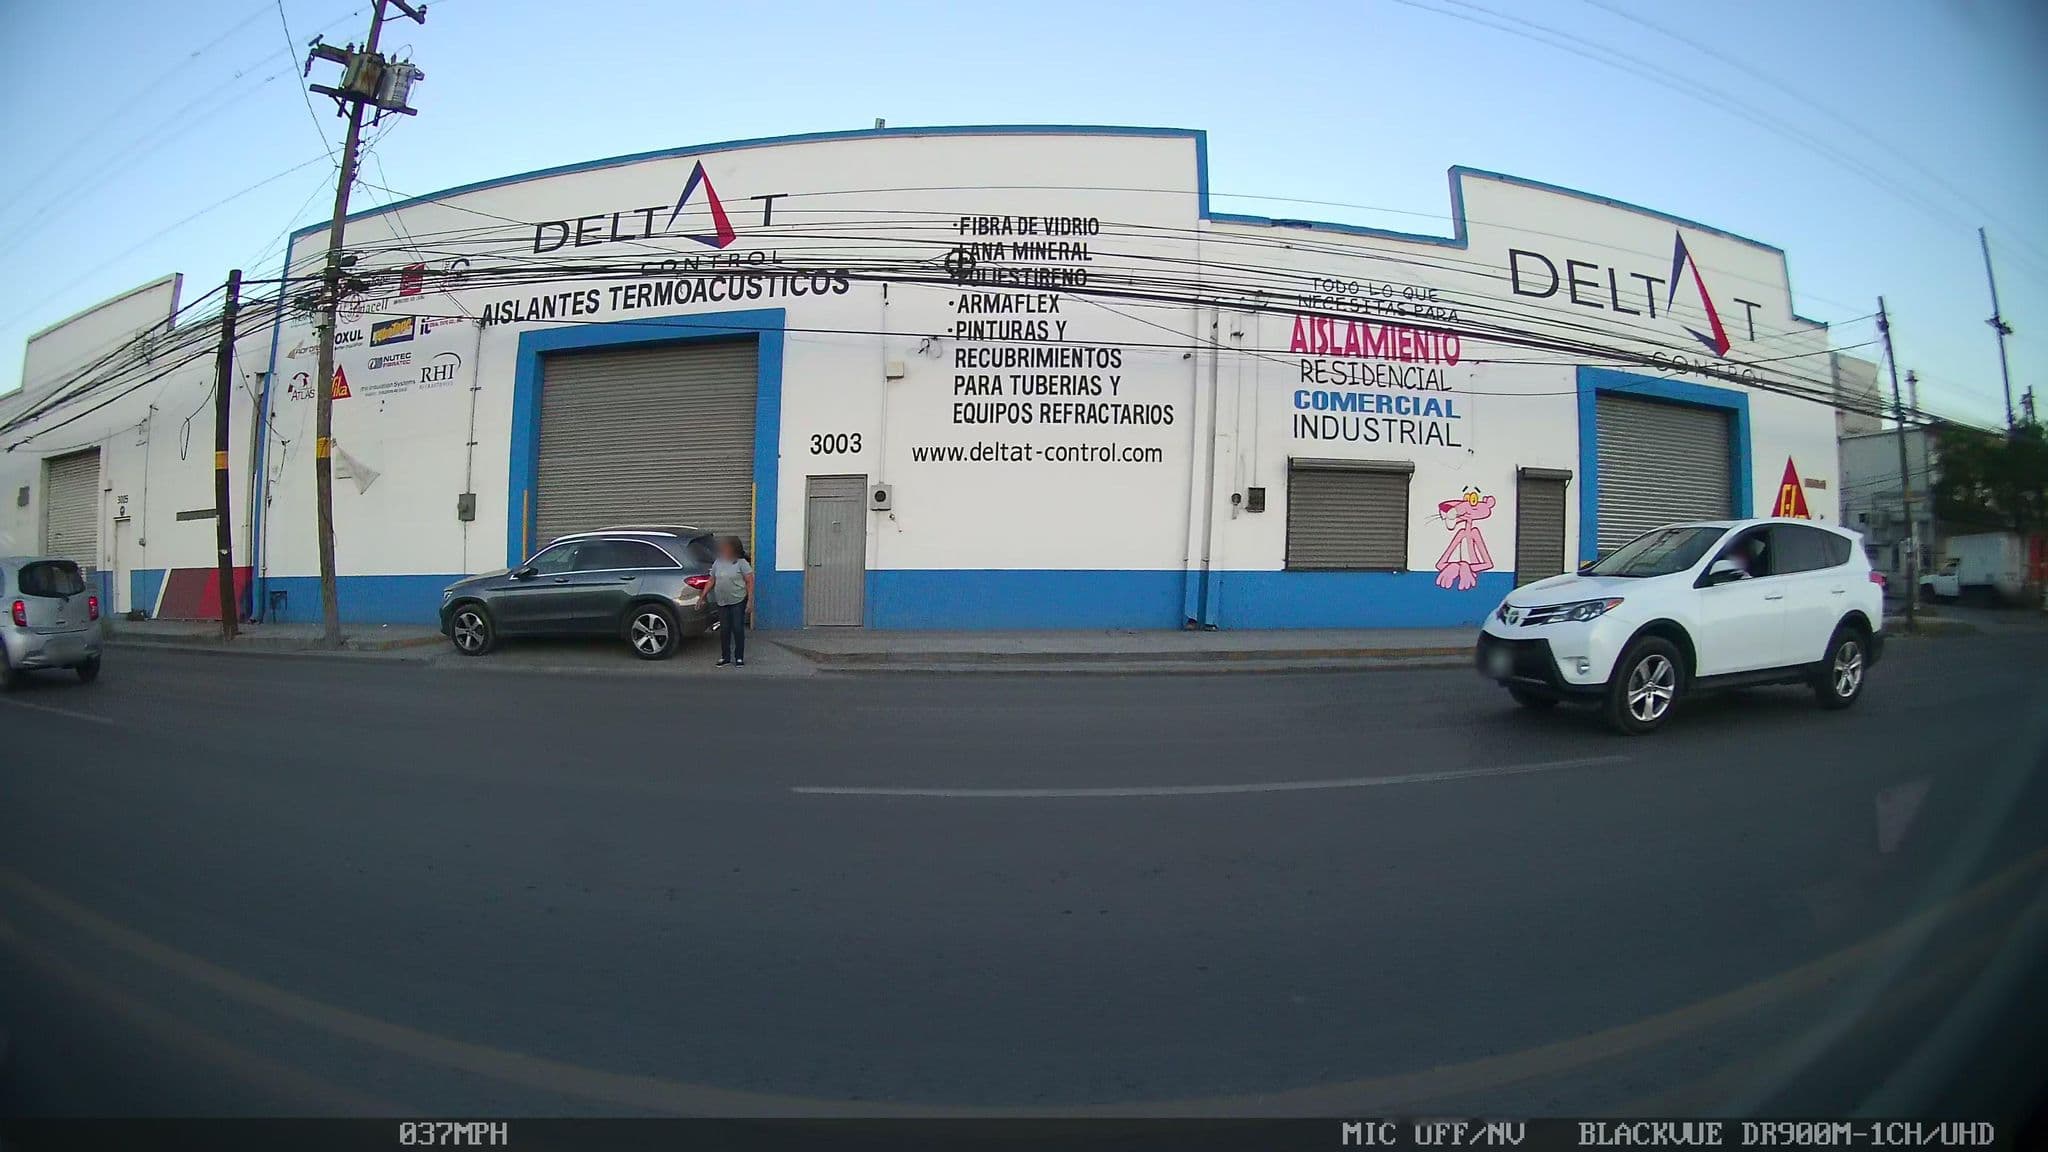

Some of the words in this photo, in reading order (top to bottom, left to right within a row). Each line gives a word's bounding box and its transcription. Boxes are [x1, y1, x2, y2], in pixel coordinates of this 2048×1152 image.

[959, 216, 1012, 236] FIBRA
[1018, 217, 1040, 236] DE
[1044, 217, 1100, 236] VIDRIO
[1012, 242, 1093, 262] MINERAL
[957, 266, 1088, 288] OLIESTIRENO
[481, 288, 602, 330] AISLANTES
[607, 268, 851, 311] TERMOACUSTICOS
[1311, 277, 1359, 295] TODO
[1369, 282, 1394, 298] LO
[1402, 287, 1440, 303] QUE
[957, 294, 1060, 314] ARMAFLEX
[1298, 294, 1408, 317] NECESITAS
[1415, 305, 1460, 324] PARA
[334, 329, 364, 345] OXUL
[955, 321, 1049, 341] PINTURAS
[1055, 321, 1068, 341] Y
[1289, 314, 1461, 367] AISLAMIENTO
[382, 352, 412, 363] NUTEC
[955, 348, 1122, 369] RECUBRIMIENTOS
[420, 363, 456, 383] RHI
[1300, 358, 1453, 392] RESIDENCIAL
[954, 375, 1003, 396] PARA
[1010, 375, 1102, 396] TUBERIAS
[1109, 375, 1122, 397] Y
[952, 403, 1033, 425] EQUIPOS
[1039, 404, 1175, 426] REFRACTARIOS
[1294, 389, 1462, 419] COMERCIAL
[1293, 413, 1462, 448] INDUSTRIAL
[810, 432, 863, 455] 3003
[912, 442, 1163, 463] www.deltat-control.com
